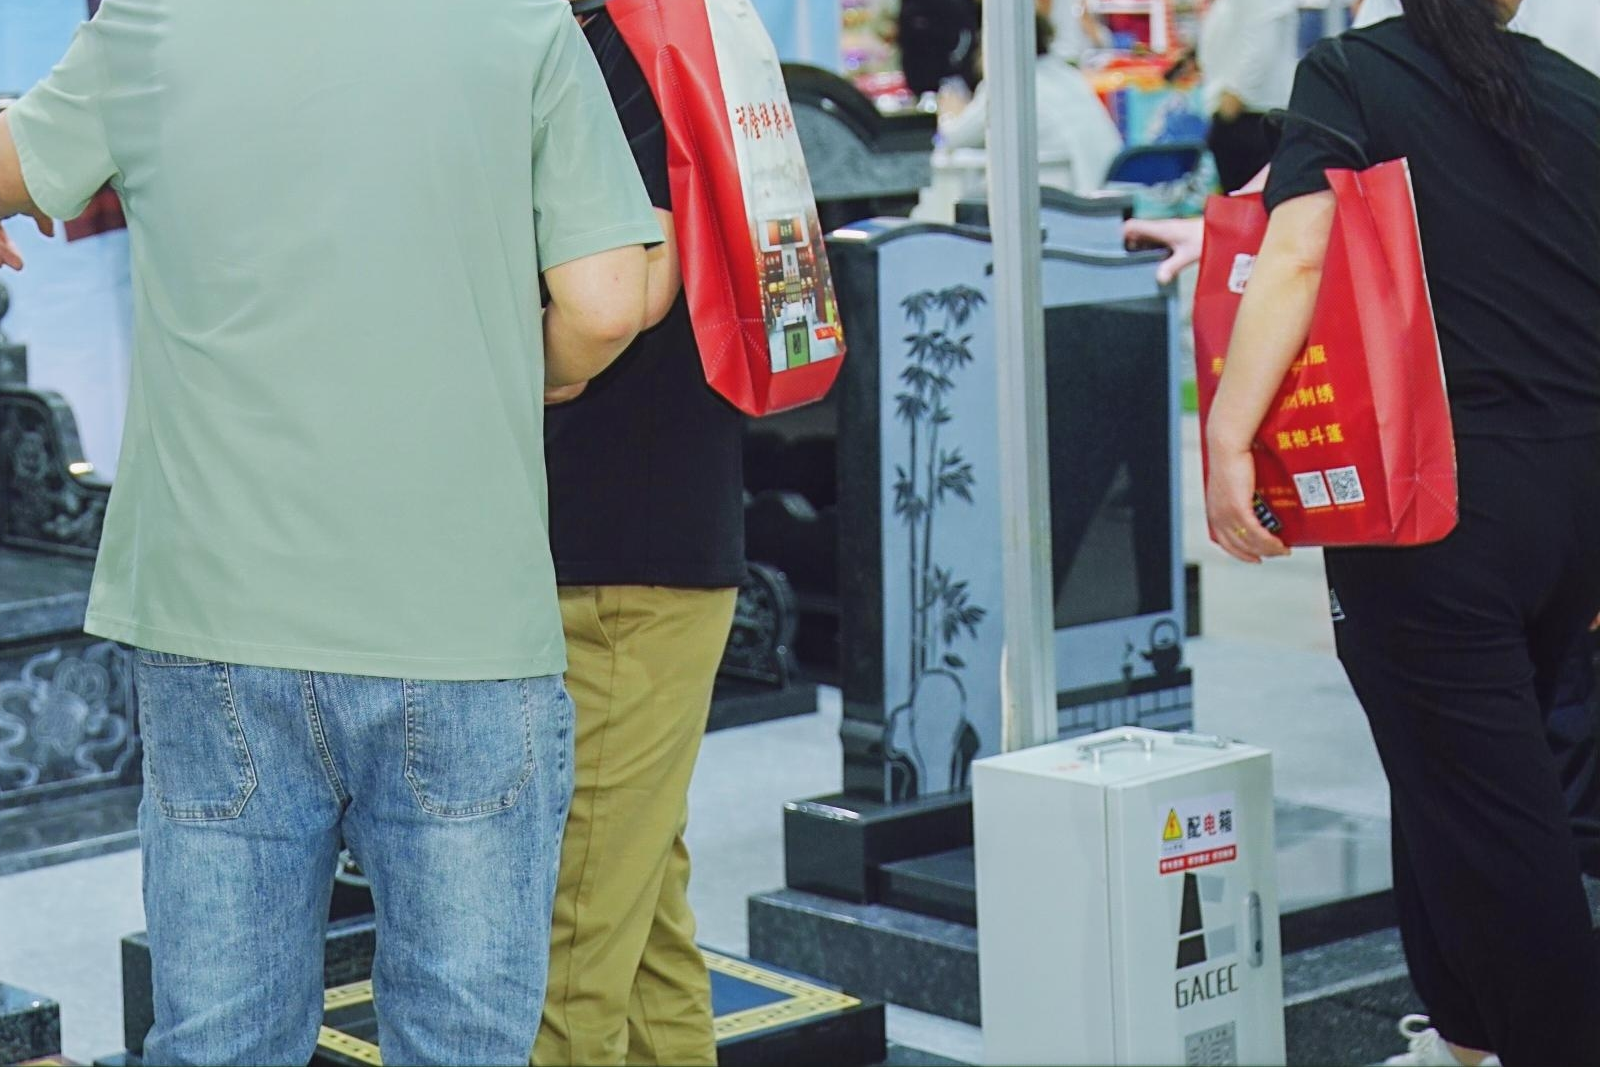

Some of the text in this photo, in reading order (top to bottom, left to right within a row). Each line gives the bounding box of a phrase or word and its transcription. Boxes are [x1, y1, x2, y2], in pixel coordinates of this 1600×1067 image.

[1187, 809, 1232, 839] 配电箱
[1175, 963, 1239, 1009] GACEC
